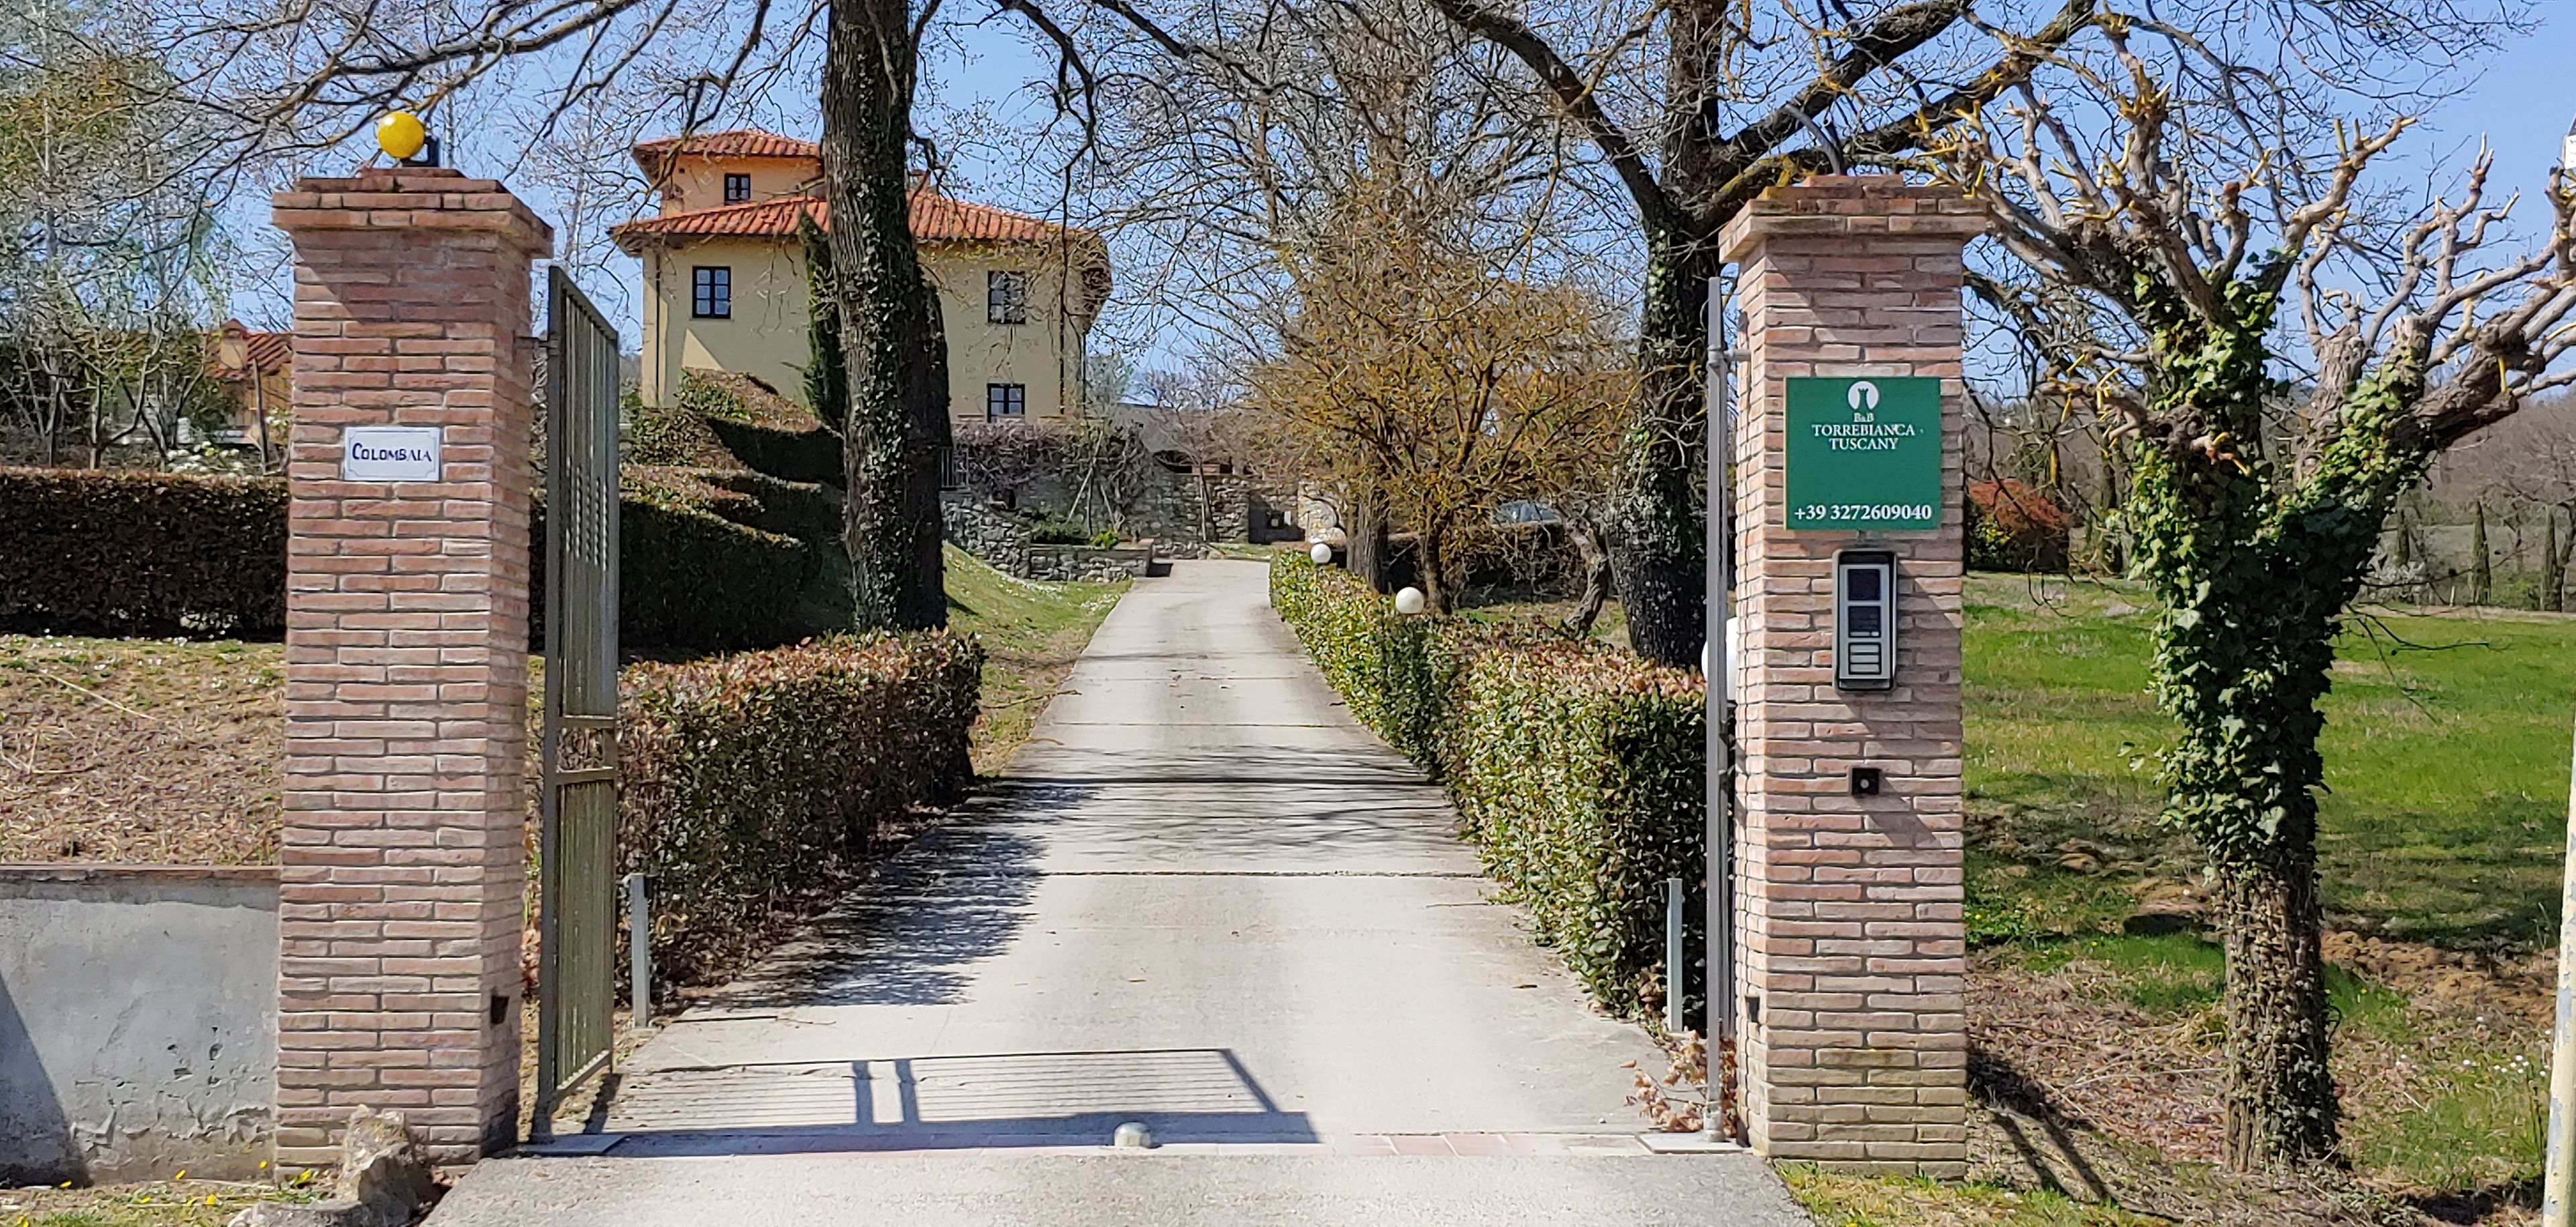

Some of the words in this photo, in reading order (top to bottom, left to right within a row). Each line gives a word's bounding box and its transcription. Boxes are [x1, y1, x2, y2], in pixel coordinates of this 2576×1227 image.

[1811, 423, 1915, 437] TORREBIANCA
[1829, 437, 1899, 450] TUSCANY
[352, 442, 432, 462] COLOMBAIA
[1794, 504, 1827, 520] +39
[1830, 504, 1932, 520] 3272609040
